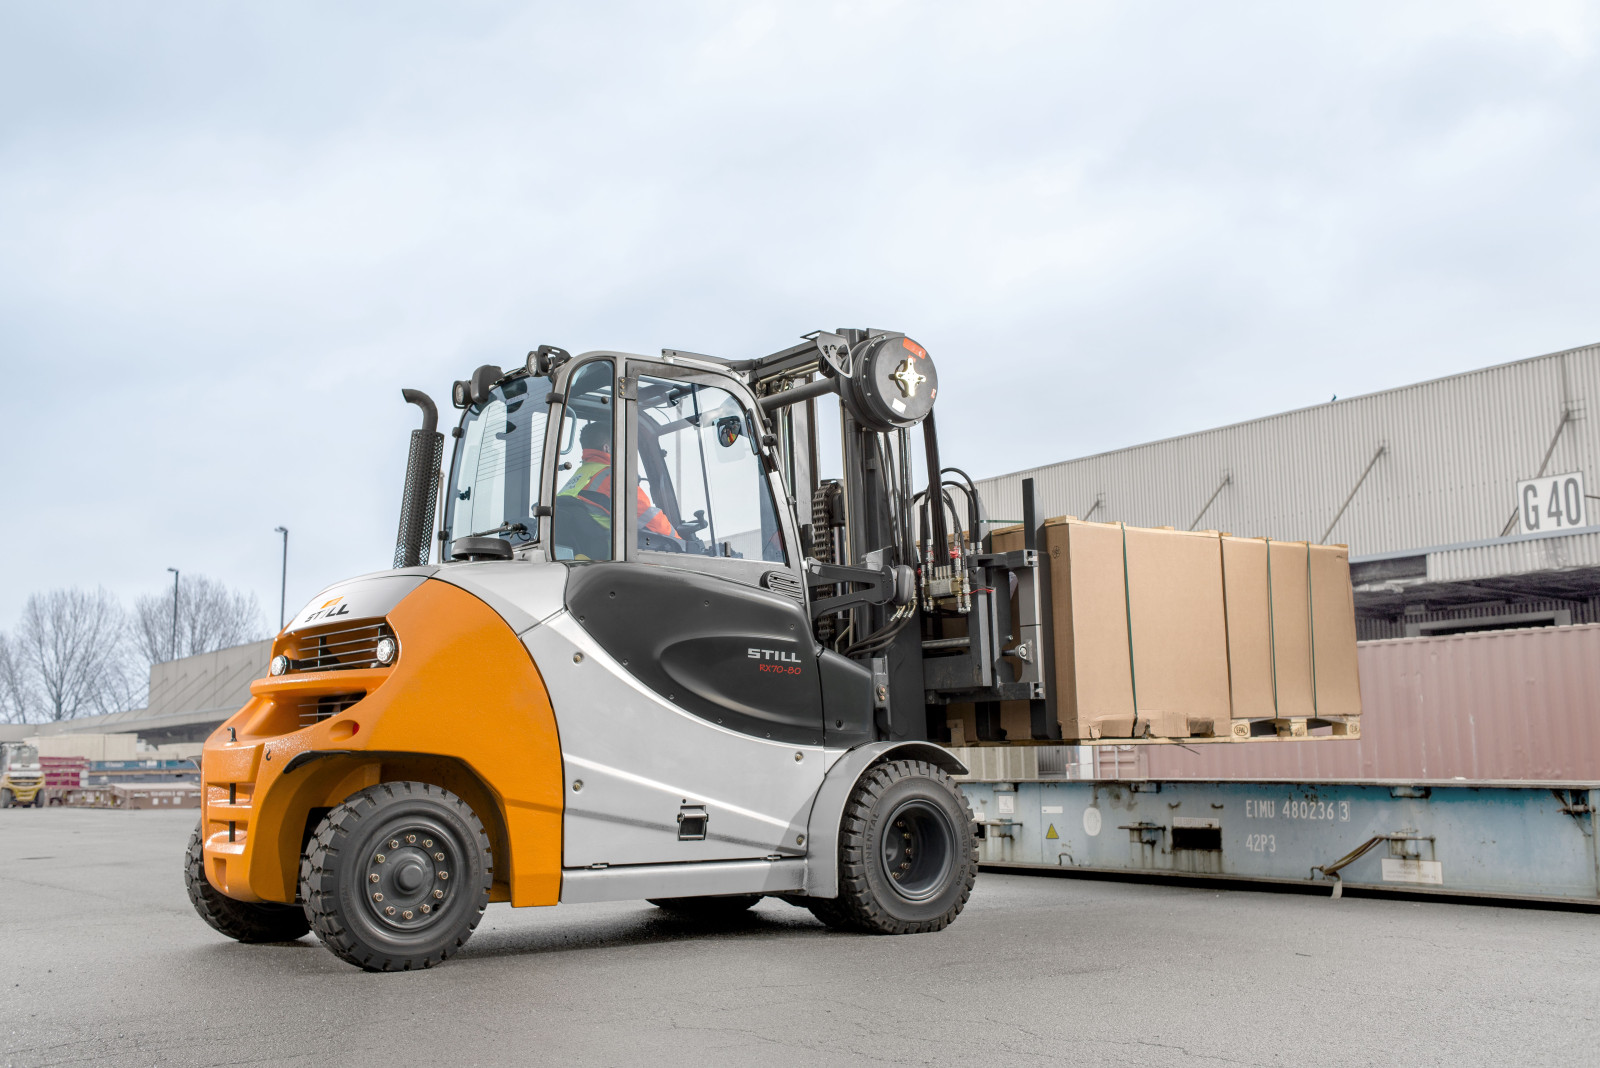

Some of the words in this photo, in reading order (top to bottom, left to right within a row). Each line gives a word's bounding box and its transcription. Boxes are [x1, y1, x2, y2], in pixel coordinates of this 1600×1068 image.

[1523, 484, 1540, 531] G
[1547, 478, 1580, 526] 40
[304, 603, 350, 623] STILL
[747, 648, 801, 663] STILL
[759, 664, 801, 675] RX70-80
[1246, 800, 1275, 818] EIMU
[1282, 801, 1334, 819] 480236
[1340, 802, 1349, 821] 3
[1245, 834, 1276, 852] 42P3
